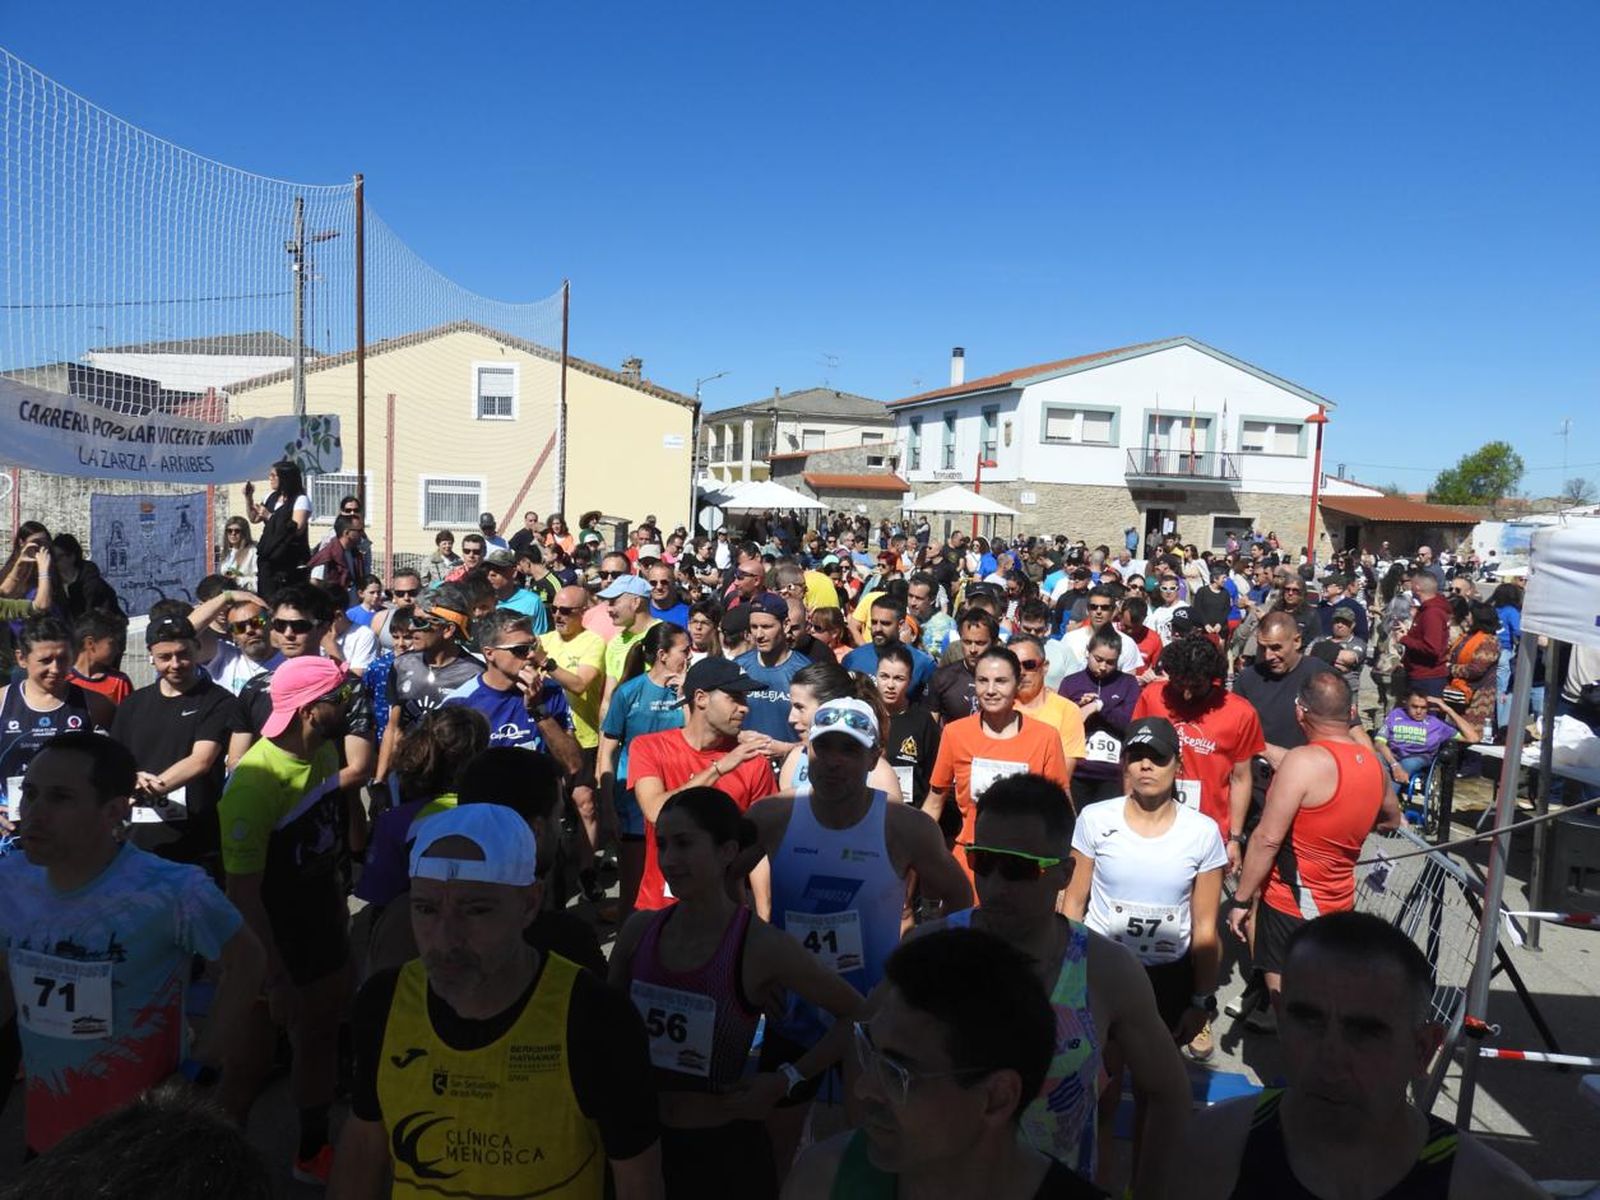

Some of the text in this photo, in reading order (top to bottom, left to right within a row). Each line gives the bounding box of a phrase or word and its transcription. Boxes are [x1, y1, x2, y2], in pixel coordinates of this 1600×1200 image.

[19, 400, 90, 435] CARRERA
[158, 426, 207, 446] VICENTE
[78, 446, 99, 467] LA
[100, 449, 148, 472] ZARZA
[160, 455, 215, 473] ARRIBES
[1127, 916, 1162, 938] 57
[803, 930, 838, 954] 41
[34, 976, 76, 1013] 71
[647, 1007, 689, 1044] 56
[446, 1128, 513, 1149] CLÍNICA
[446, 1146, 545, 1166] MENORCA
